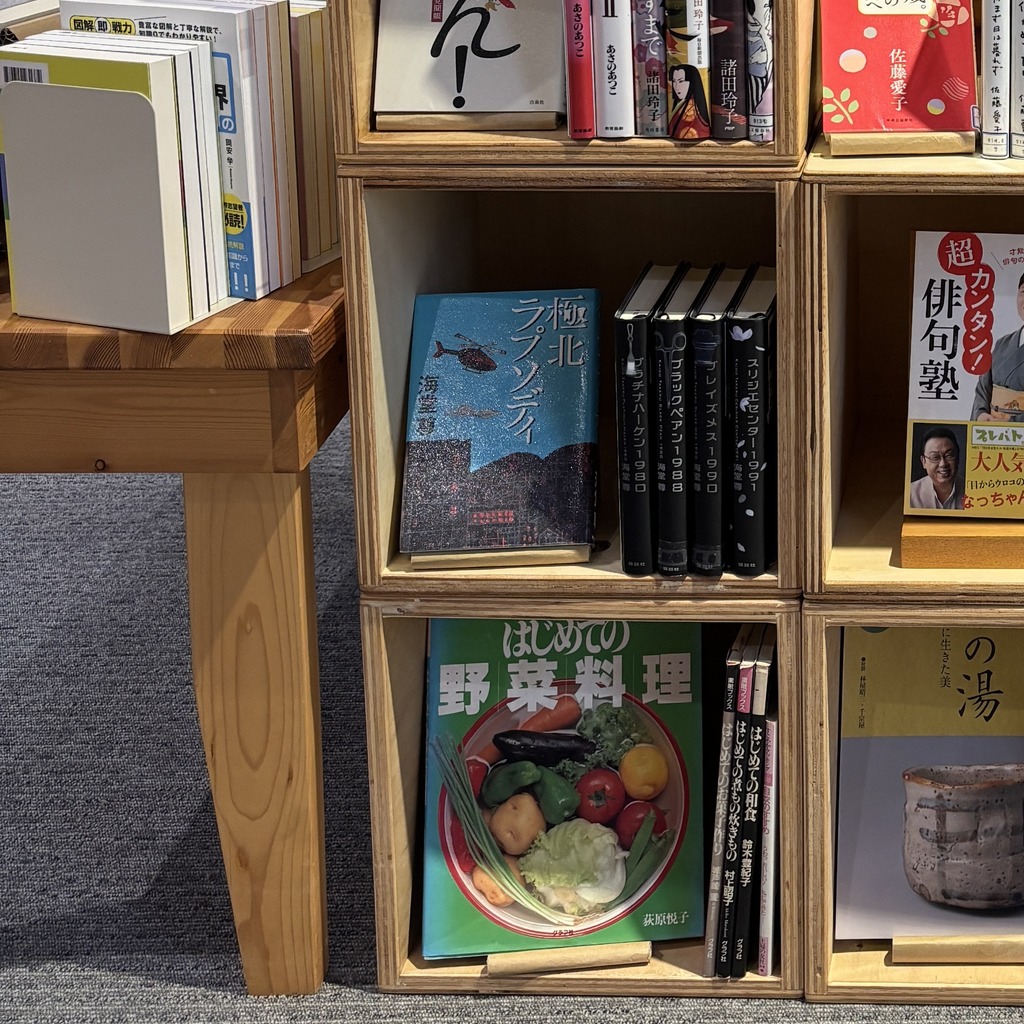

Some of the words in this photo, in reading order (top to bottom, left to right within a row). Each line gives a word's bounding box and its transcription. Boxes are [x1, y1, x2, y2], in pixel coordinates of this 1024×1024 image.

[571, 3, 584, 58] あさのあつこ
[606, 44, 618, 96] あさのあつこ
[645, 70, 660, 123] 諸田玲子
[720, 58, 738, 125] 諸田玲子
[889, 48, 908, 112] 佐藤愛子
[945, 237, 975, 269] 超
[546, 296, 588, 368] 極北
[918, 278, 963, 401] 俳句塾
[969, 268, 992, 372] カンタン！
[506, 297, 546, 445] ラプソディ
[670, 358, 684, 494] ブラックペアン1988
[705, 360, 718, 494] ブレイズメス1990
[502, 620, 631, 658] はじめての
[940, 627, 952, 688] に生きた美
[438, 652, 692, 716] 野菜料理
[957, 636, 1004, 723] の湯
[726, 719, 747, 862] はじめての煮もの炊きもの
[744, 726, 763, 823] はじめての和食
[722, 870, 735, 907] 村上昭子
